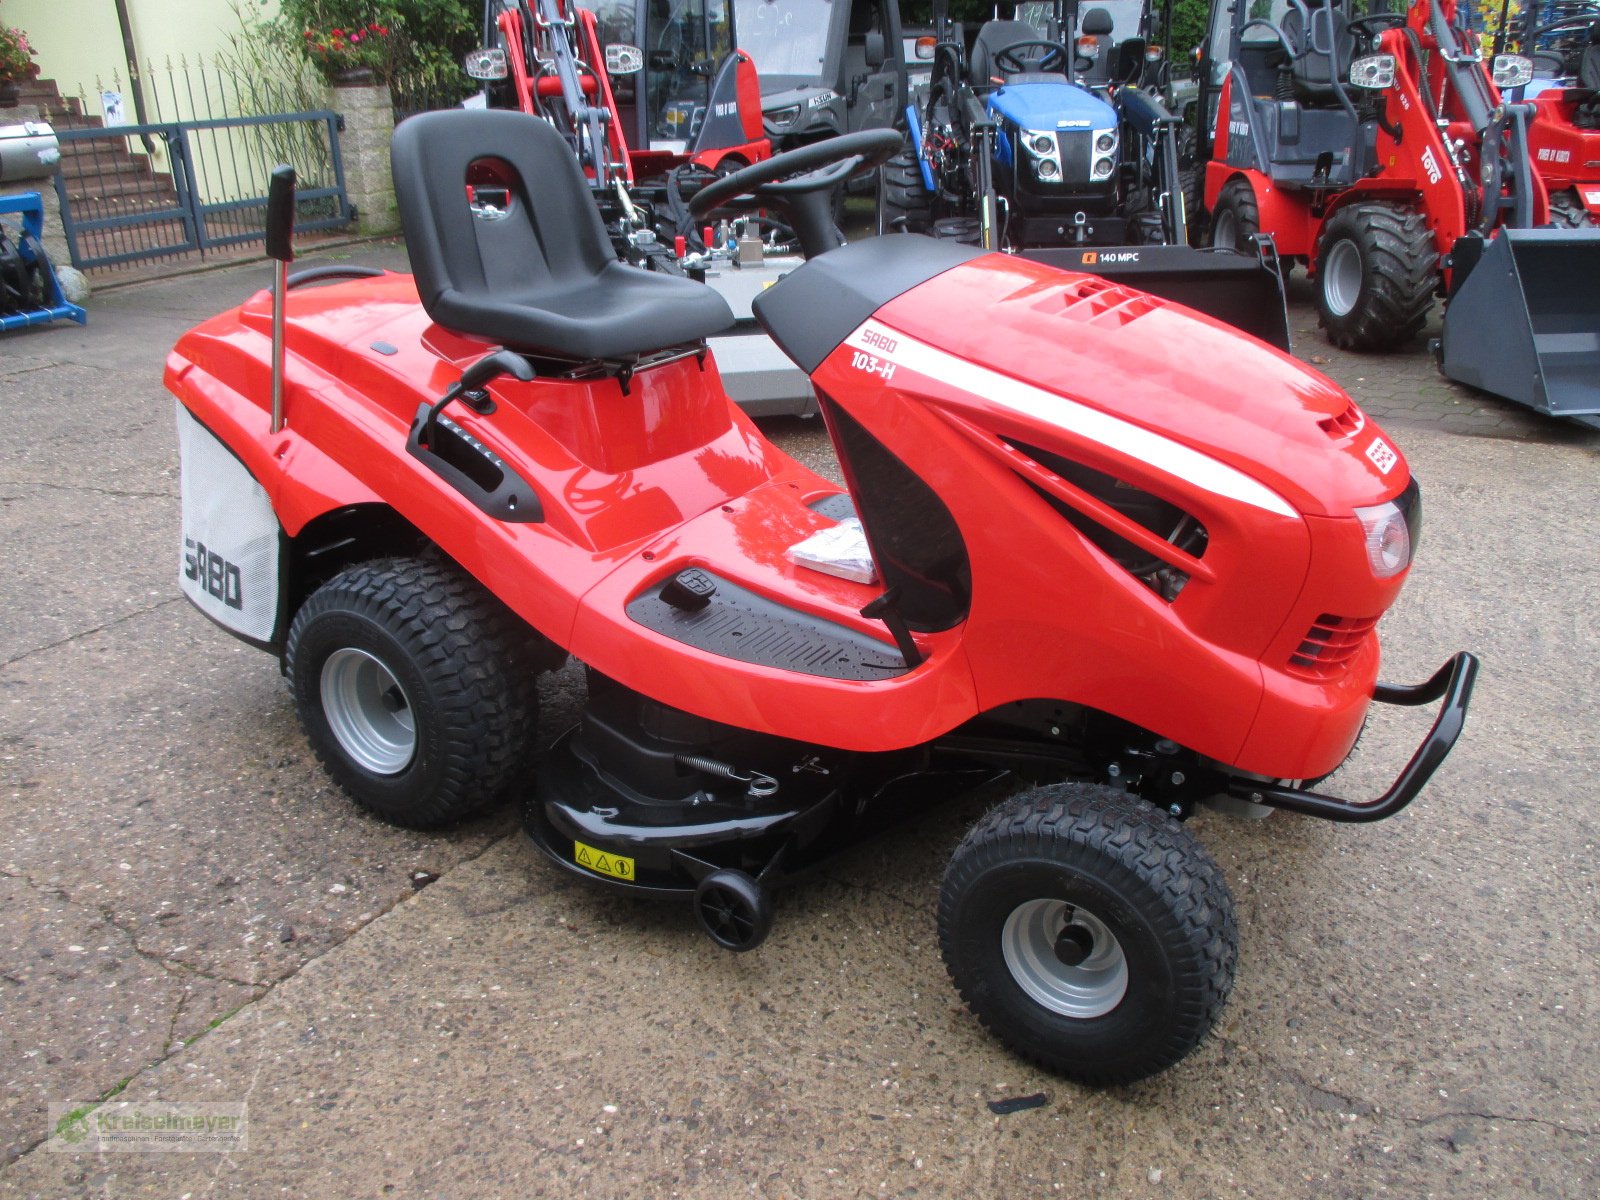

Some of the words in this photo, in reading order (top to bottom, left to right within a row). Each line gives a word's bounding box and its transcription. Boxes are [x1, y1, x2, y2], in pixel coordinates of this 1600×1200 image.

[1421, 145, 1442, 184] TOYO
[1100, 253, 1117, 262] 140
[1117, 252, 1140, 262] MPC
[861, 328, 898, 354] SABO
[851, 351, 897, 380] 103-H
[185, 535, 243, 611] SABO
